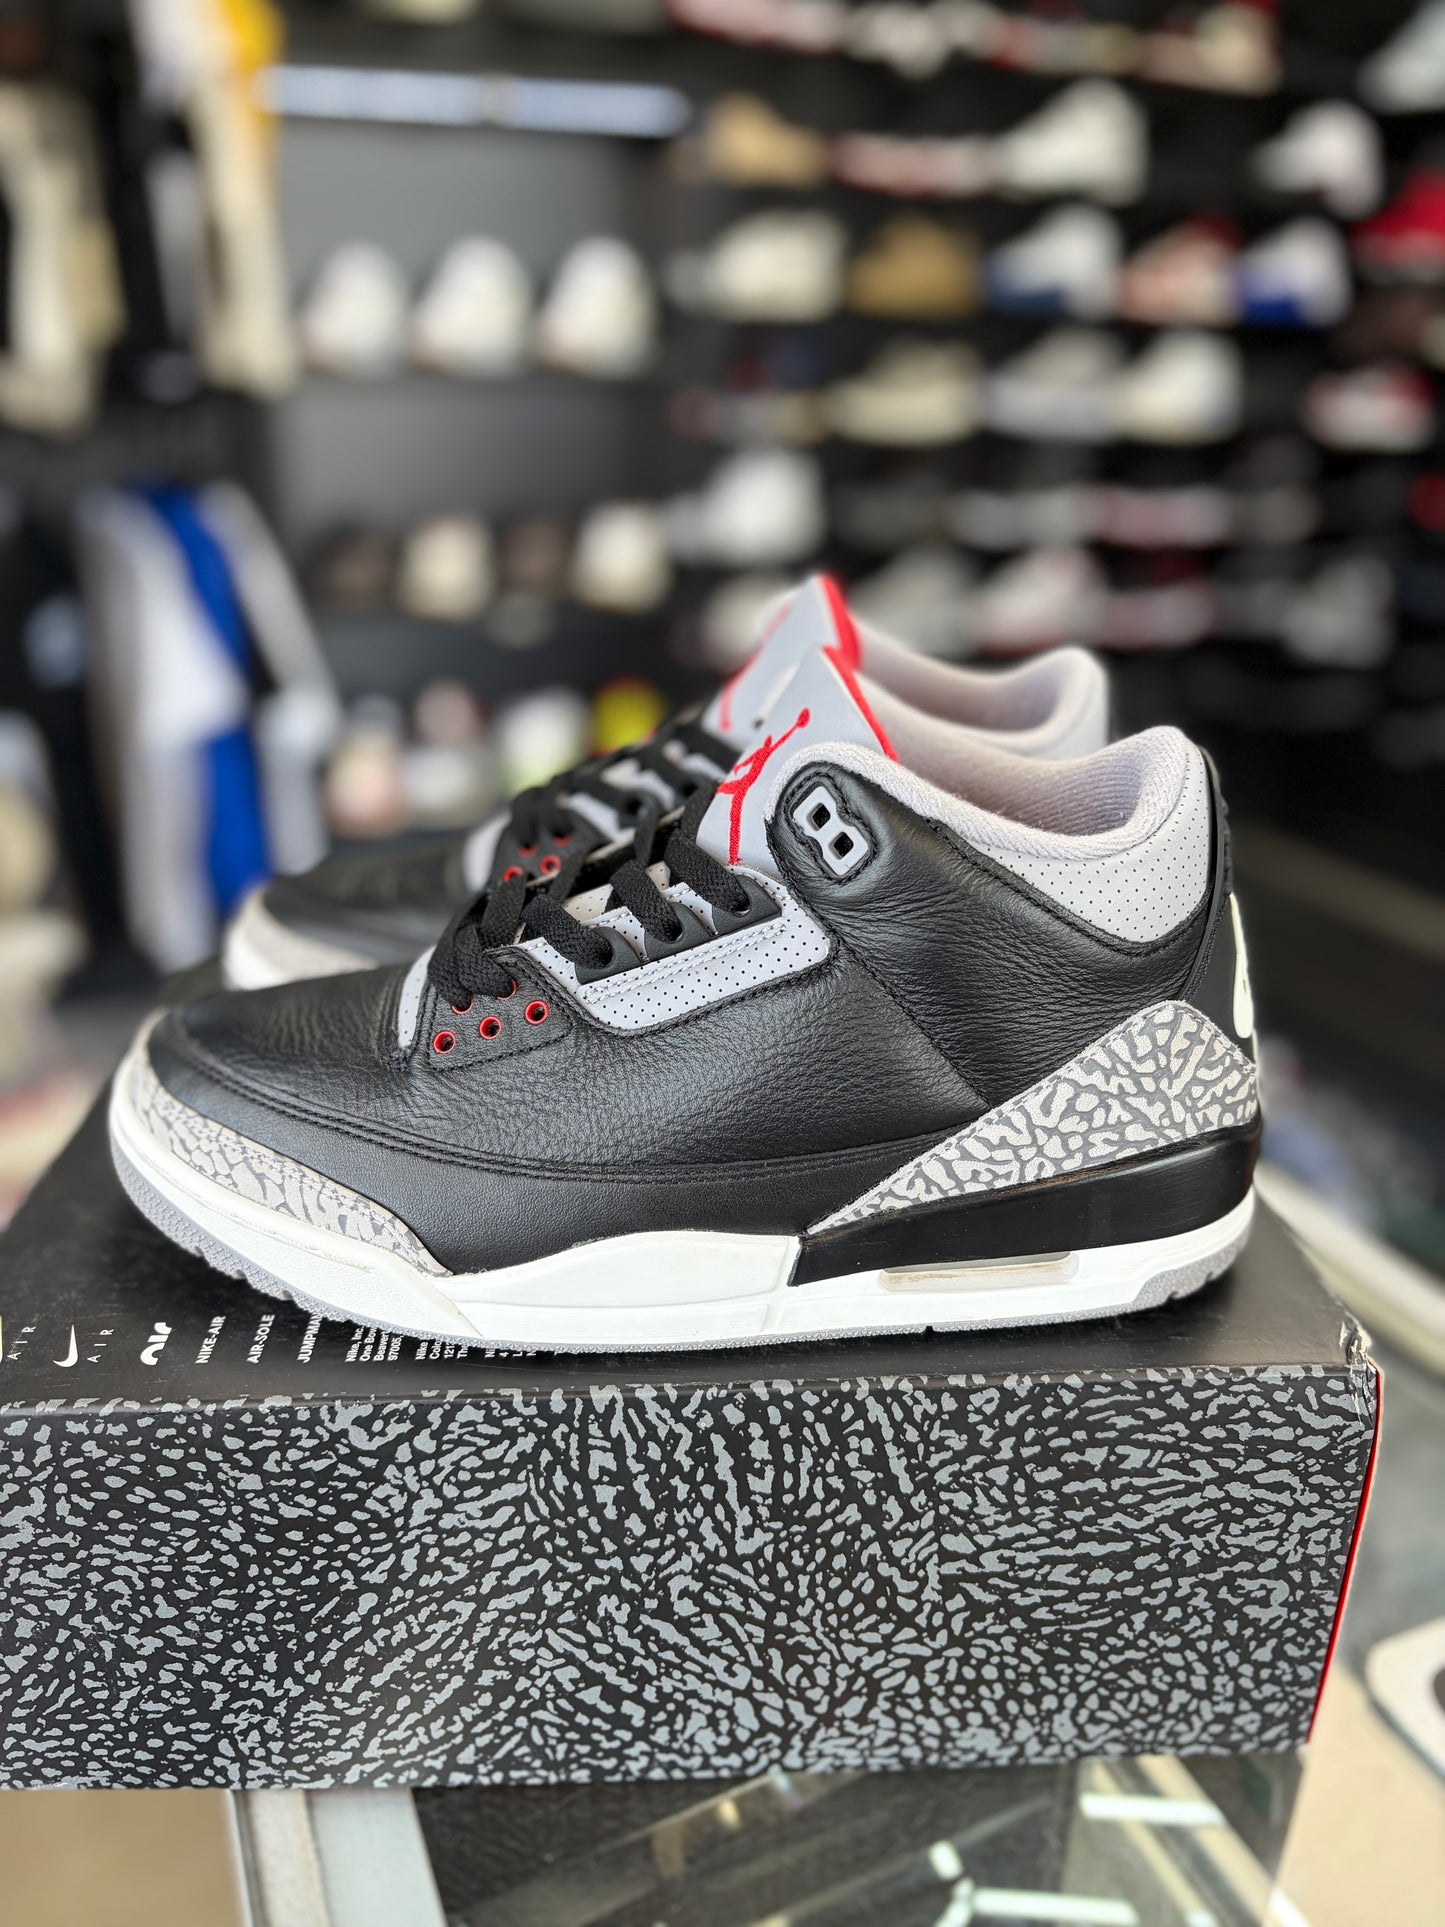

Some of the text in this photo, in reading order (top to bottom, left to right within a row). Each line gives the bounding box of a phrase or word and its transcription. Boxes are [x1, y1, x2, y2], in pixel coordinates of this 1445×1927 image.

[7, 1326, 37, 1360] AIR
[87, 1329, 114, 1363] AIR
[195, 1316, 226, 1364] NIKE-AIR
[246, 1314, 275, 1364] AIR-SOLE
[345, 1341, 362, 1362] Nike,
[360, 1344, 373, 1361] One
[415, 1341, 429, 1360] Nike
